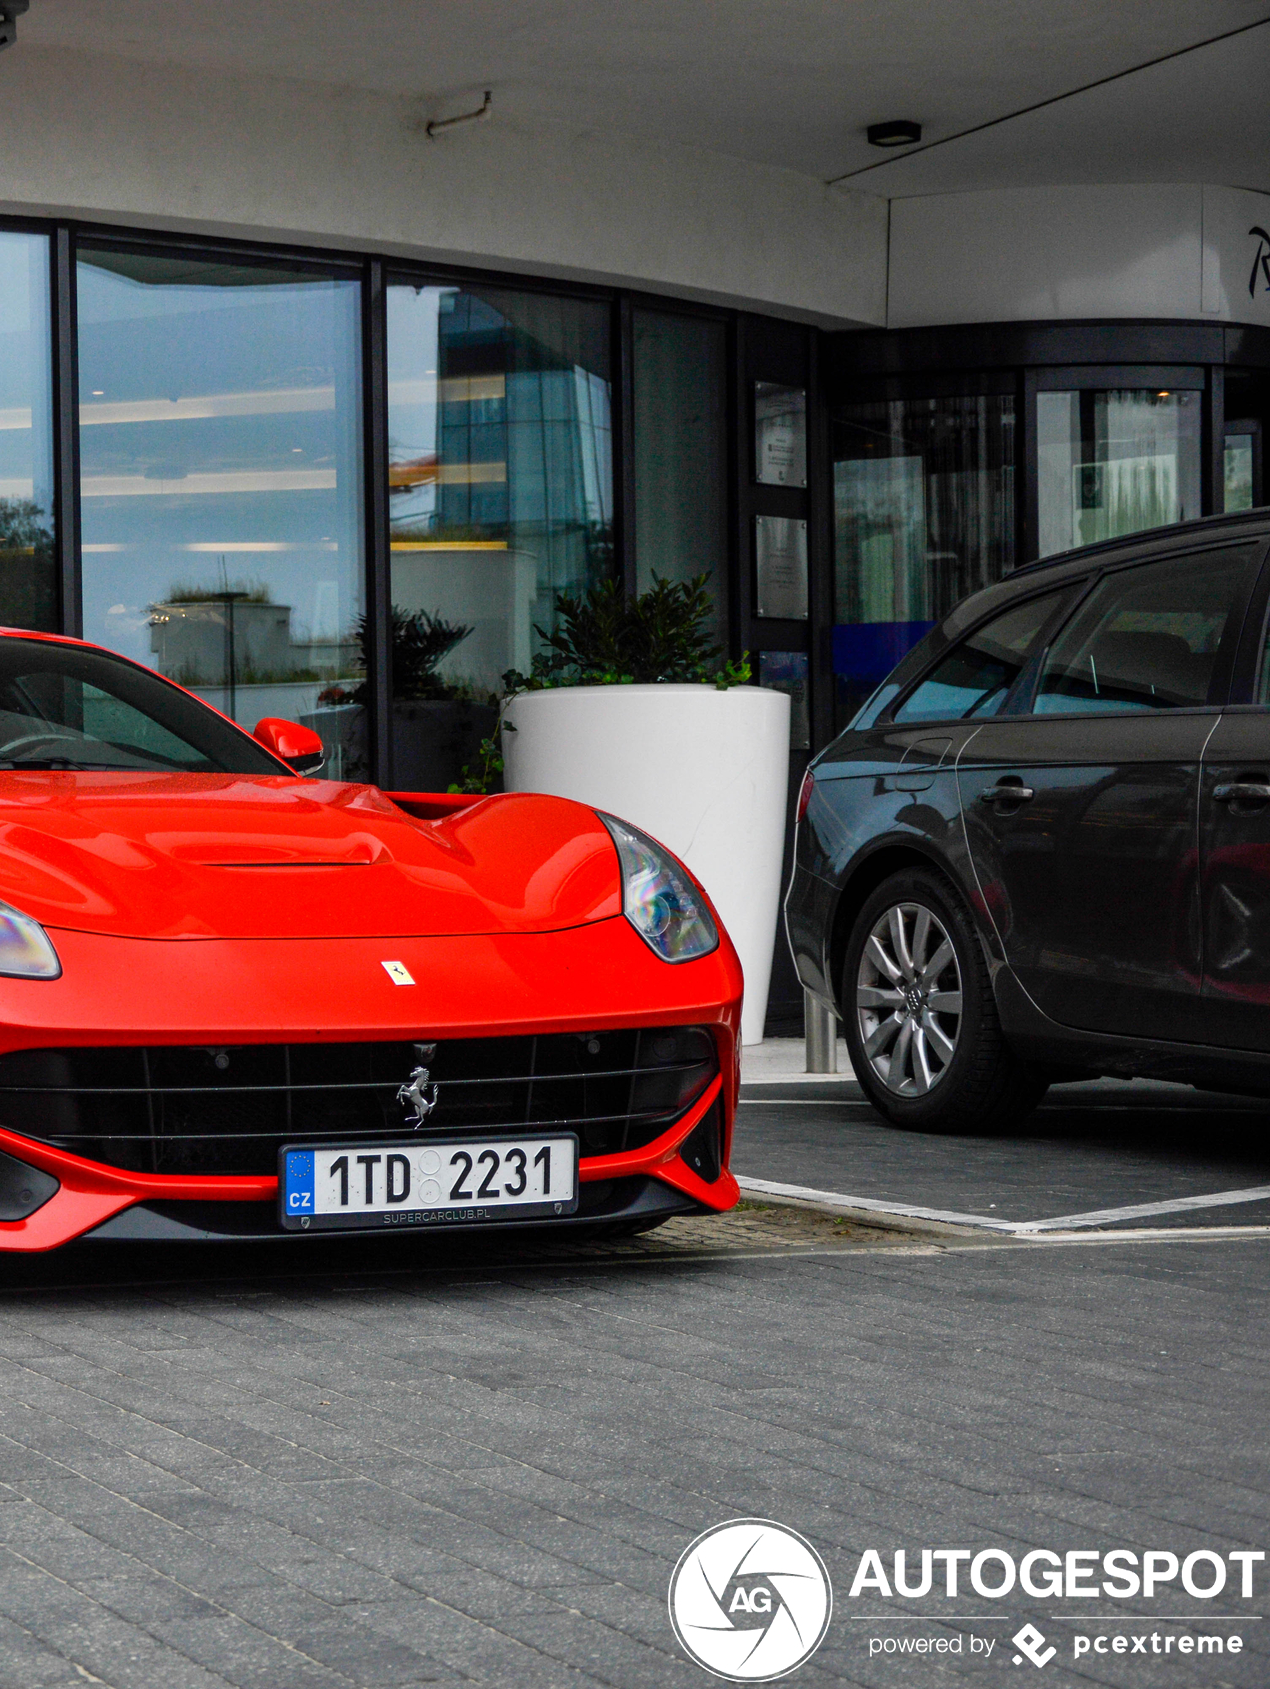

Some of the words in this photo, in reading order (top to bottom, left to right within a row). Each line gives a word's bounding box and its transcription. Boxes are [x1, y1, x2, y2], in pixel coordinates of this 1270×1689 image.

[330, 1154, 411, 1206] 1TD
[449, 1146, 551, 1201] 2231
[289, 1192, 311, 1208] CZ
[383, 1209, 491, 1225] SUPERCARCLUB.PL
